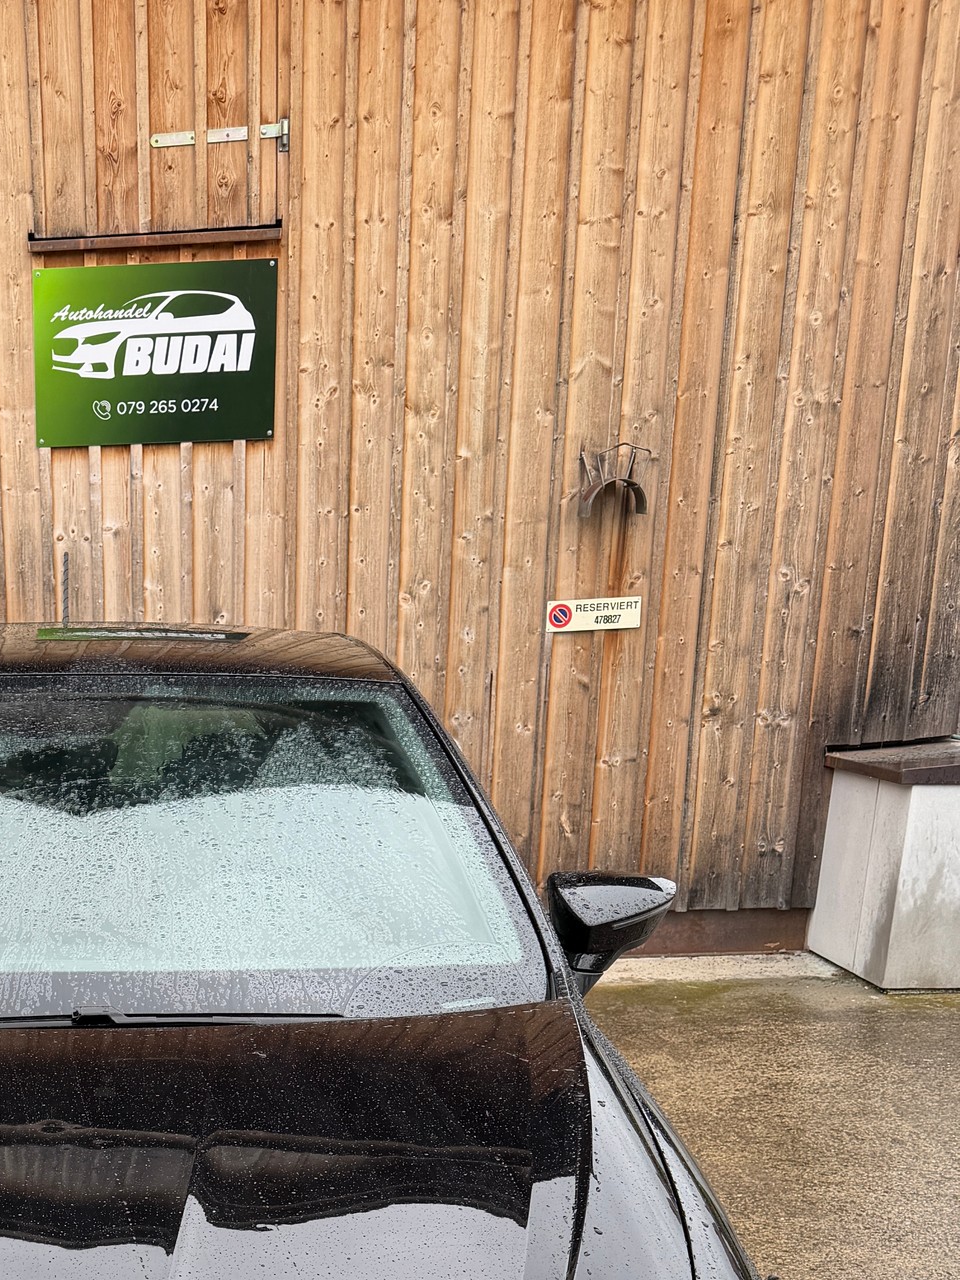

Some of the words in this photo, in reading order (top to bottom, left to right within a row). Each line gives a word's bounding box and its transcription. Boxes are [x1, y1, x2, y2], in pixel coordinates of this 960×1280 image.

[50, 302, 151, 322] Autohandel
[122, 332, 256, 376] BUDAI
[116, 401, 145, 415] 079
[149, 400, 177, 414] 265
[181, 398, 219, 413] 0274
[575, 601, 639, 612] RESERVIERT
[594, 614, 621, 624] 478827
